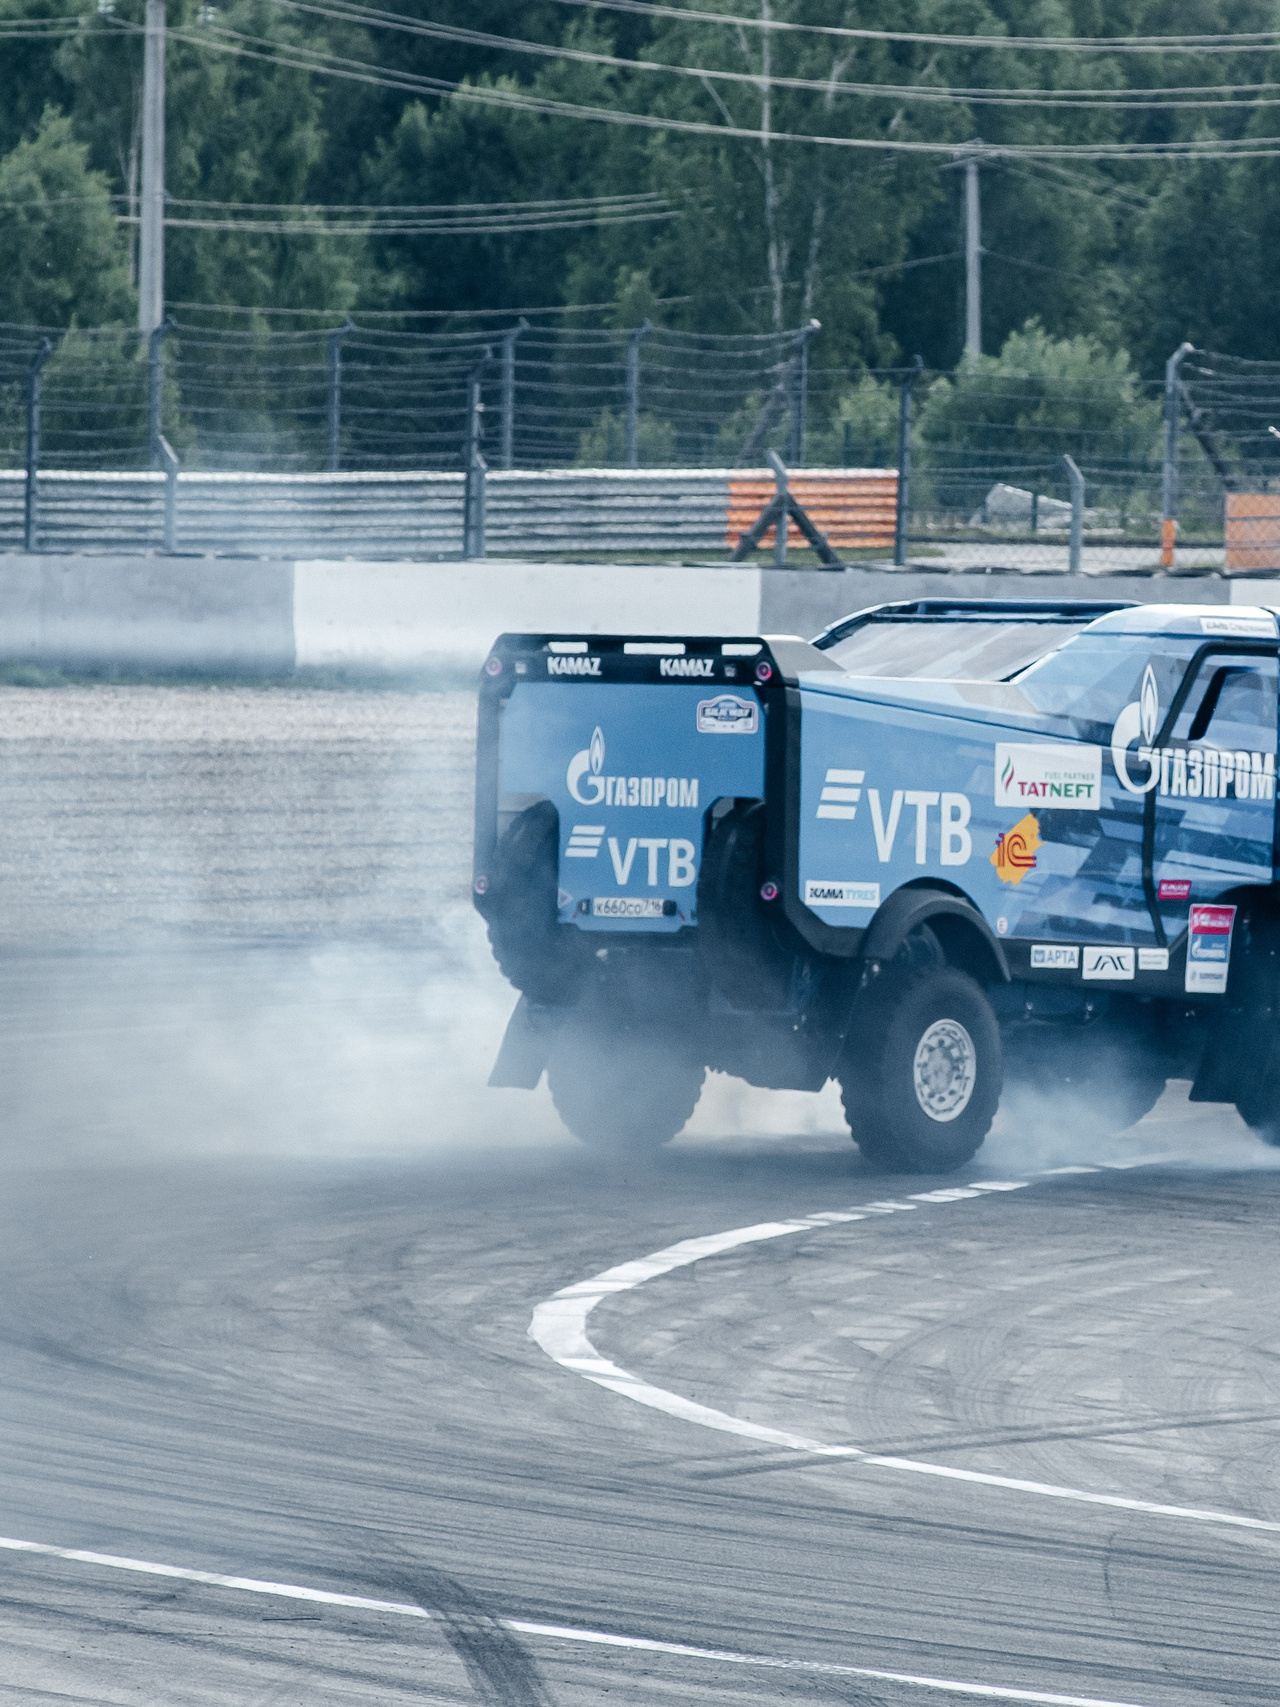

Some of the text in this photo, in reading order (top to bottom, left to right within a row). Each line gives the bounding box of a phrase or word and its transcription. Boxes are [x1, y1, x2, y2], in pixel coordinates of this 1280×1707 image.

[547, 656, 602, 676] KAMAZ
[660, 658, 715, 677] KAMAZ
[606, 776, 699, 808] ГАЗПРОМ
[1017, 781, 1095, 798] TATNEFT
[867, 788, 973, 867] VTB
[607, 837, 697, 887] VTB
[810, 887, 844, 899] KAMA
